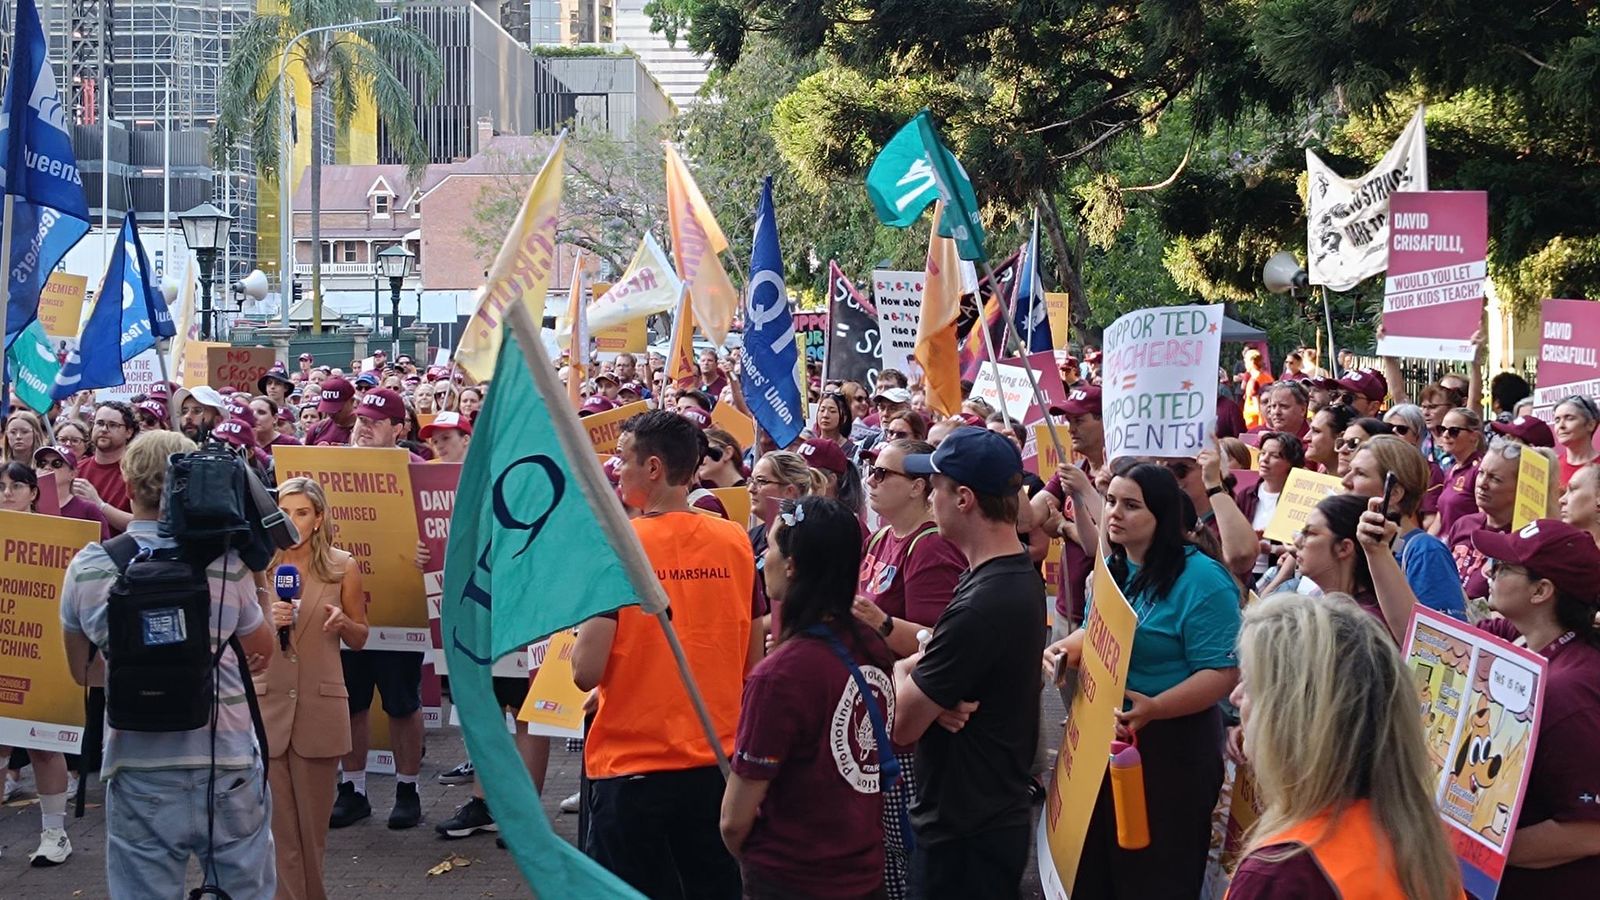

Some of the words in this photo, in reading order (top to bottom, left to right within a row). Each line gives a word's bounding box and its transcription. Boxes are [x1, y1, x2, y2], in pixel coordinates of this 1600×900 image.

[1394, 213, 1428, 229] DAVID
[1393, 234, 1464, 254] CRISAFULLI,
[1394, 273, 1429, 291] WOULD
[1431, 269, 1451, 284] YOU
[1453, 265, 1471, 280] LET
[880, 296, 900, 306] How
[903, 297, 921, 308] abo
[1388, 294, 1415, 310] YOUR
[1416, 290, 1440, 306] KIDS
[1442, 283, 1480, 302] TEACH?
[883, 313, 889, 321] a
[891, 325, 909, 335] rise
[1544, 321, 1572, 340] DAVID
[227, 351, 250, 364] NO
[1542, 344, 1598, 369] CRISAFULLI,
[134, 360, 150, 370] THE
[19, 365, 48, 394] Union
[125, 371, 153, 382] ACHER
[322, 390, 340, 399] QTU
[363, 395, 386, 407] QTU
[763, 385, 793, 425] Union
[420, 490, 457, 511] DAVI
[332, 506, 377, 521] OMISED
[5, 538, 81, 570] PREMIE
[669, 567, 731, 581] MARSHALL
[0, 577, 56, 600] ROMISED
